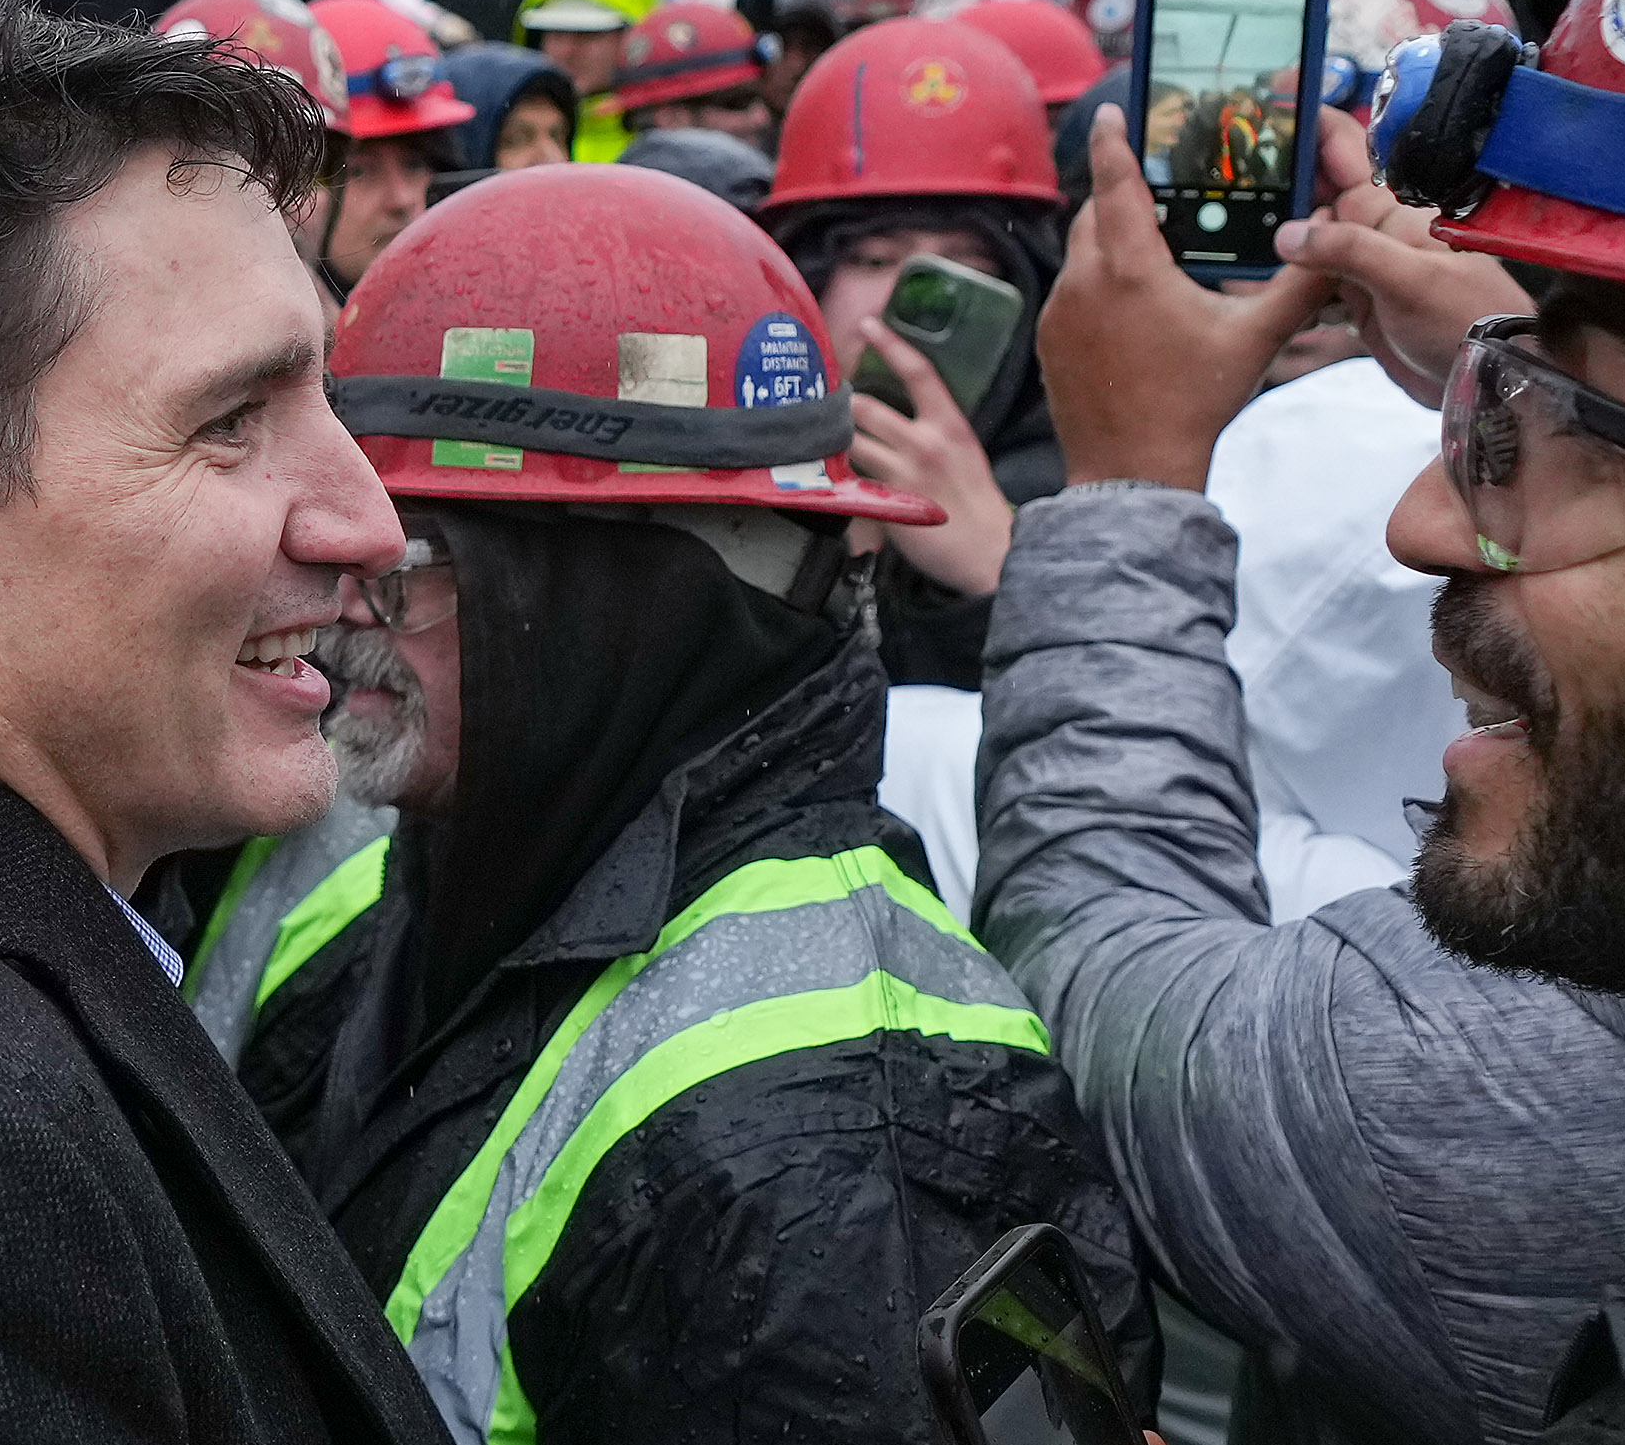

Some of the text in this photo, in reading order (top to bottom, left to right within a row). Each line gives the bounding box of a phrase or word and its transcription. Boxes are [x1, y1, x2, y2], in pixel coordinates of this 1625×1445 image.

[761, 341, 808, 355] MAINTAIN
[762, 356, 809, 372] DISTANCE
[774, 375, 802, 397] 6FT
